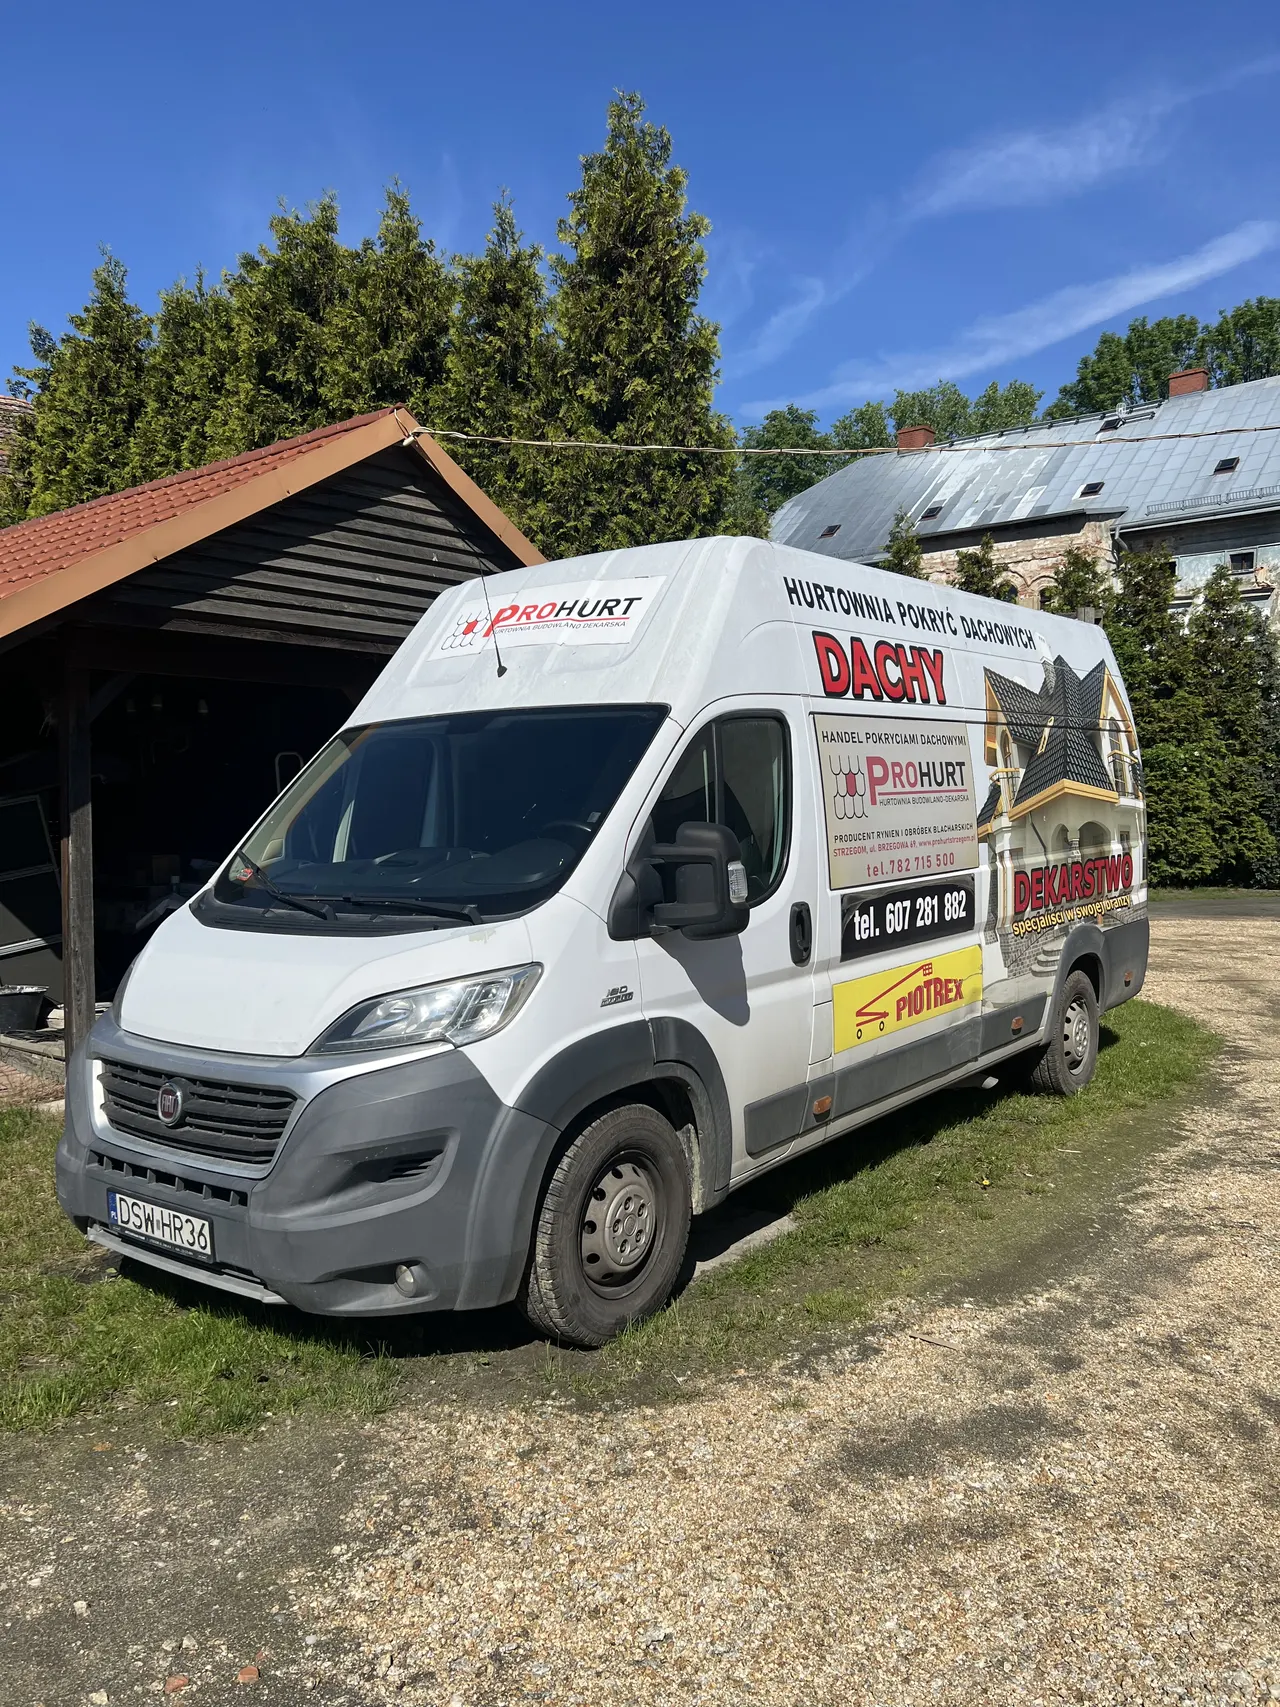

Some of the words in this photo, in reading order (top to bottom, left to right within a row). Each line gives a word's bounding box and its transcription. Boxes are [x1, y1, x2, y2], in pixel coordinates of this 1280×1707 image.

[482, 597, 643, 637] PROHURT
[493, 625, 531, 635] URTOWNIA
[582, 621, 626, 629] DEKARSKA
[784, 576, 896, 624] HURTOWNIA
[897, 601, 958, 636] POKRYĆ
[960, 616, 1037, 650] DACHOWYCH
[812, 630, 947, 705] DACHY
[821, 730, 864, 744] HANDEL
[865, 732, 919, 746] POKRYCIAMI
[921, 734, 967, 746] DACHOWYMI
[866, 756, 966, 805] PROHURT
[879, 797, 911, 807] HURTOWNIA
[834, 831, 875, 844] PRODUCENT
[876, 830, 900, 840] RYNIEN
[900, 829, 904, 837] I
[904, 825, 932, 837] OBRÓBEK
[933, 822, 974, 834] BLACHARSKICH
[833, 846, 869, 857] STRZEGOM,
[877, 842, 909, 852] BRZEGOWA
[914, 855, 932, 871] 715
[936, 852, 955, 867] 500
[1013, 851, 1134, 916] DEKARSTWO
[854, 906, 880, 941] tel.
[885, 900, 911, 934] 607
[915, 895, 939, 928] 281
[944, 889, 967, 922] 882
[1064, 908, 1076, 922] w
[896, 976, 964, 1022] PIOTREX
[110, 1210, 118, 1220] PL
[119, 1196, 155, 1235] DSW
[160, 1210, 208, 1251] HR36
